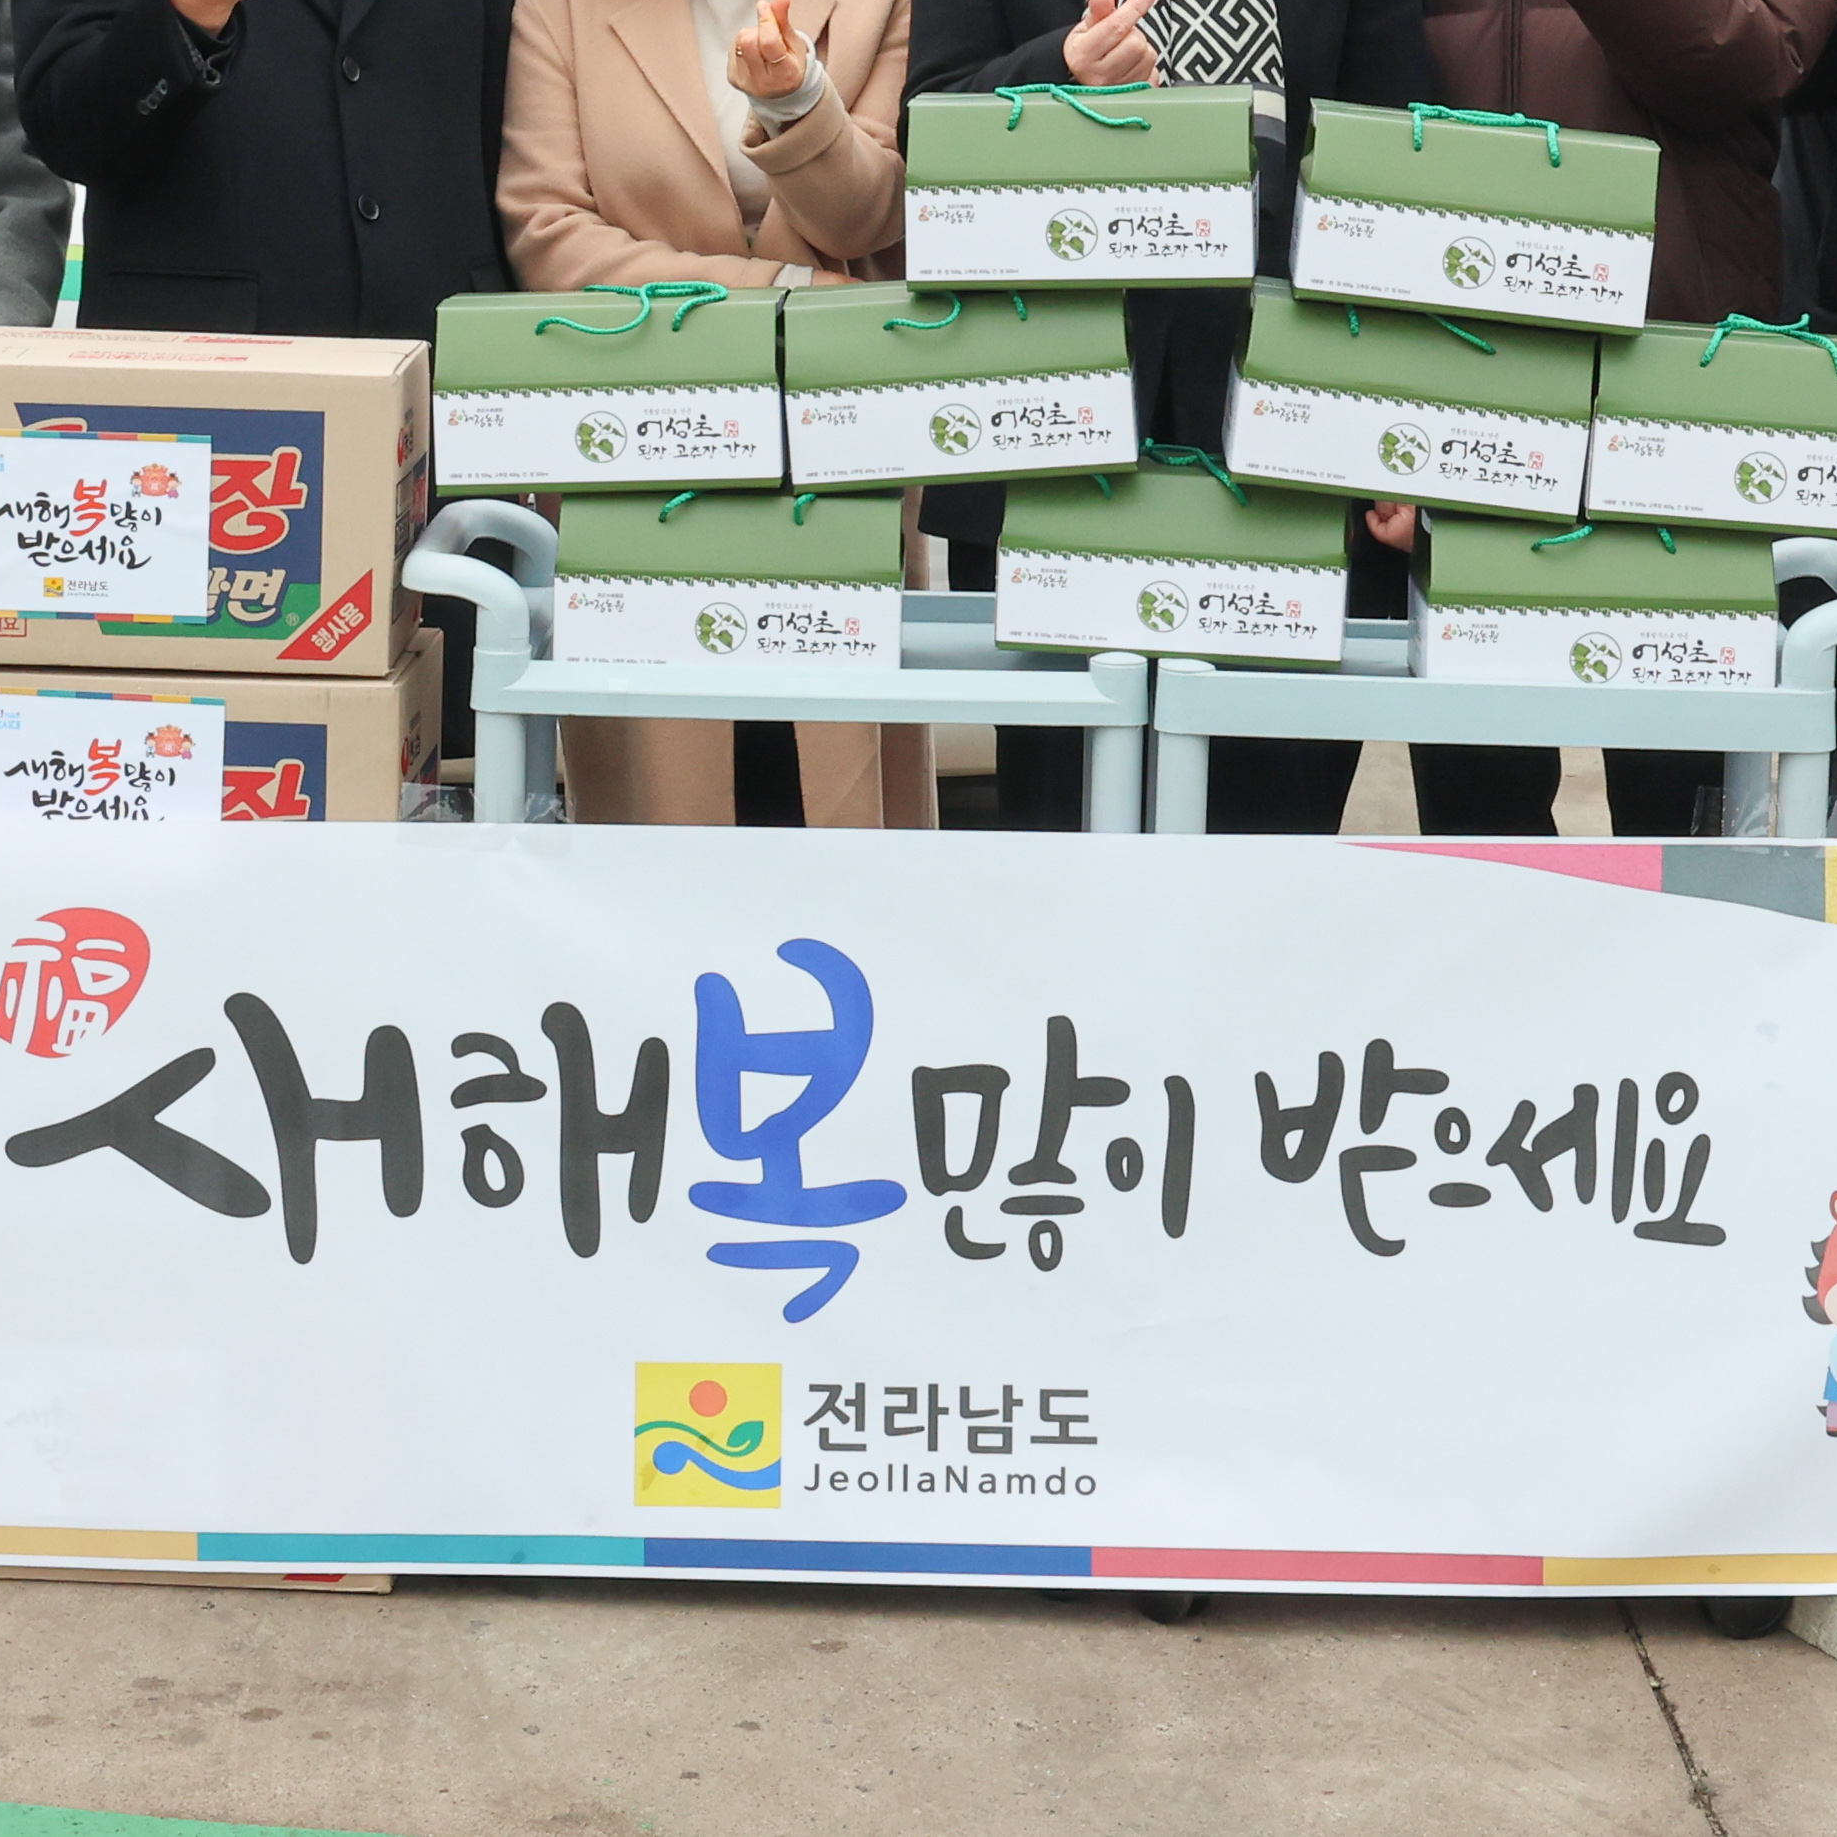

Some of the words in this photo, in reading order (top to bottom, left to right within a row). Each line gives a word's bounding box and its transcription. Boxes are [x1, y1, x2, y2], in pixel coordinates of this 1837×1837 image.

[1107, 212, 1194, 238] 어성초
[1505, 252, 1592, 280] 어성초
[636, 413, 723, 440] 어성초
[990, 401, 1077, 429] 어성초
[1440, 439, 1526, 468] 어성초
[17, 530, 152, 570] 받으세요
[67, 579, 109, 591] 전라남도
[1198, 592, 1285, 617] 어성초
[310, 601, 365, 653] 행사용
[756, 609, 843, 635] 어성초
[1631, 639, 1719, 665] 어성초
[1254, 1038, 1728, 1258] 받으세요
[803, 1380, 1099, 1454] 전라남도
[803, 1463, 1098, 1498] JeollaNamdo
